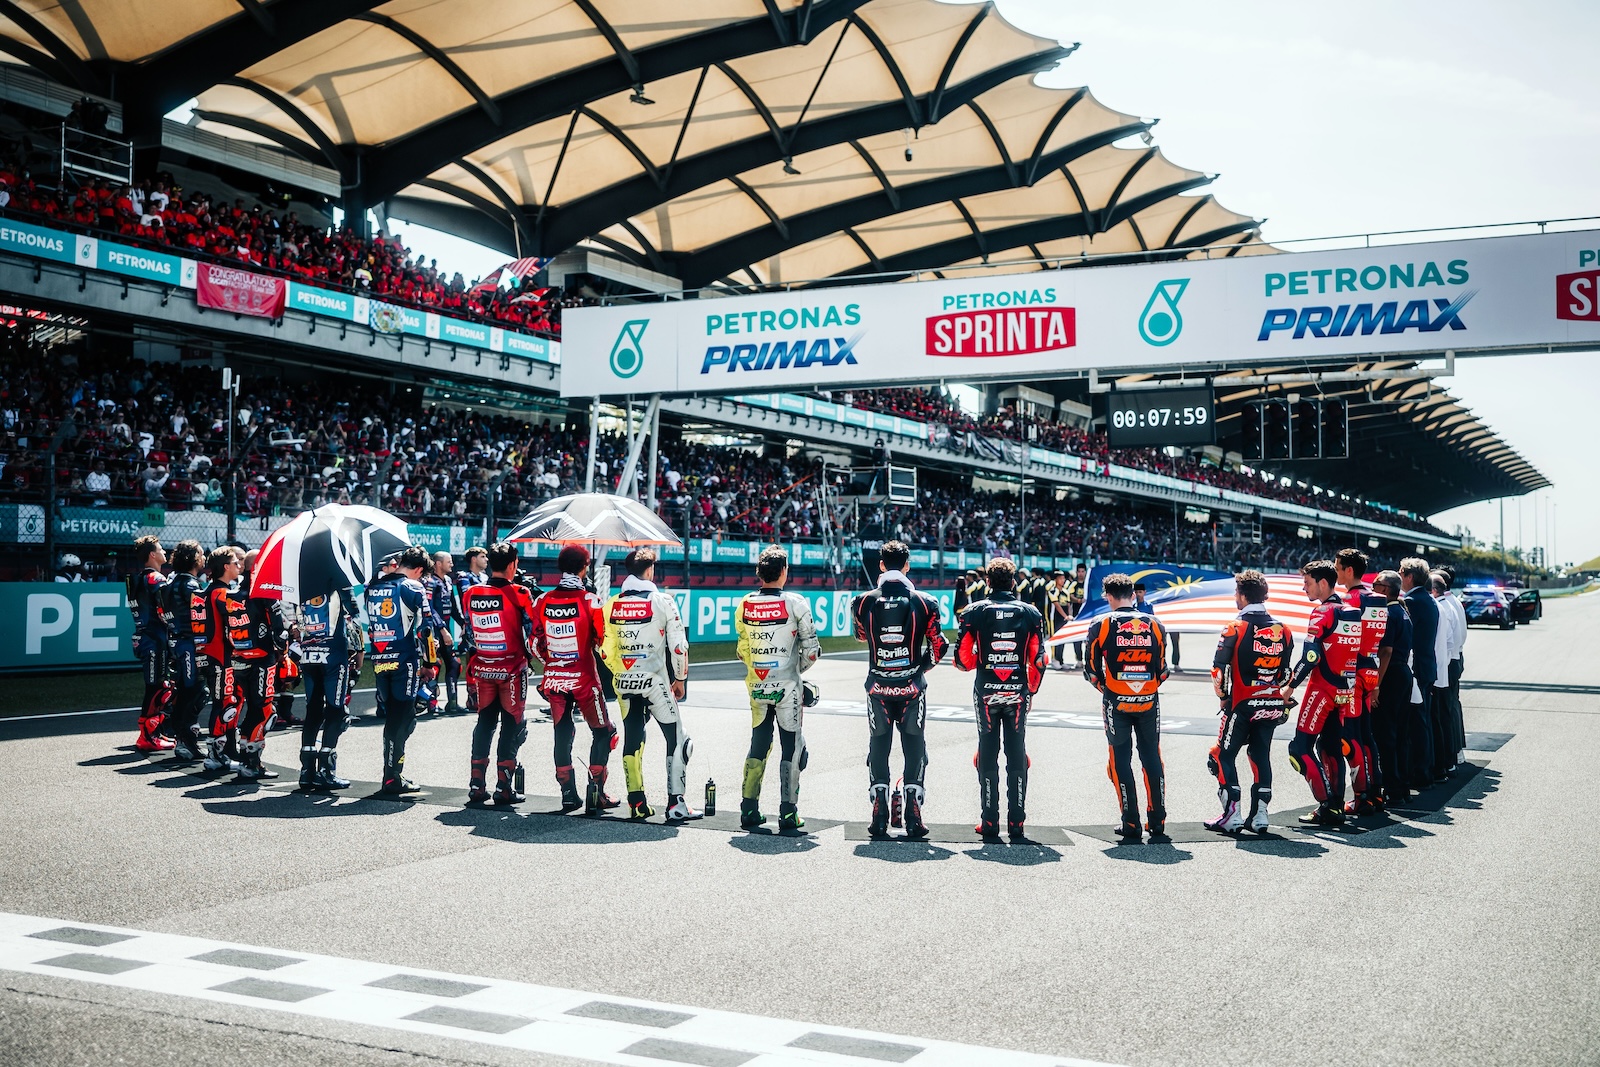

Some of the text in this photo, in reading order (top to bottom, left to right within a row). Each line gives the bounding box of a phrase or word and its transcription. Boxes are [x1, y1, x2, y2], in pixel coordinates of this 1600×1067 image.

[0, 227, 64, 252] ETRONAS
[108, 251, 171, 275] PETRONAS
[1579, 248, 1600, 268] P
[208, 266, 276, 289] CONGRATULATIONS
[1264, 258, 1470, 297] PETRONAS
[297, 291, 347, 312] PETRONAS
[943, 287, 1057, 311] PETRONAS
[1569, 277, 1600, 316] S
[706, 303, 861, 336] PETRONAS
[1257, 293, 1474, 342] PRIMAX
[445, 324, 485, 342] PETRONAS
[934, 311, 1068, 354] SPRINTA
[508, 337, 544, 355] PETRONAS
[700, 333, 866, 375] PRIMAX
[1112, 406, 1208, 429] 00:07:59
[61, 518, 139, 535] PETRONAS
[261, 516, 267, 531] 1
[408, 533, 442, 547] RONAS
[716, 547, 745, 557] PETRONAS
[25, 592, 132, 655] PE
[749, 630, 775, 641] ebay
[1117, 635, 1136, 647] Red
[751, 647, 778, 655] DUCATI
[877, 646, 910, 660] aprilia
[987, 651, 1019, 663] aprilia
[1117, 649, 1153, 663] KTM
[1253, 640, 1274, 655] Red
[983, 682, 1023, 691] DAINESE
[1117, 695, 1155, 704] DAINESE
[1299, 690, 1320, 728] HONDA
[1308, 697, 1328, 732] DAINESE
